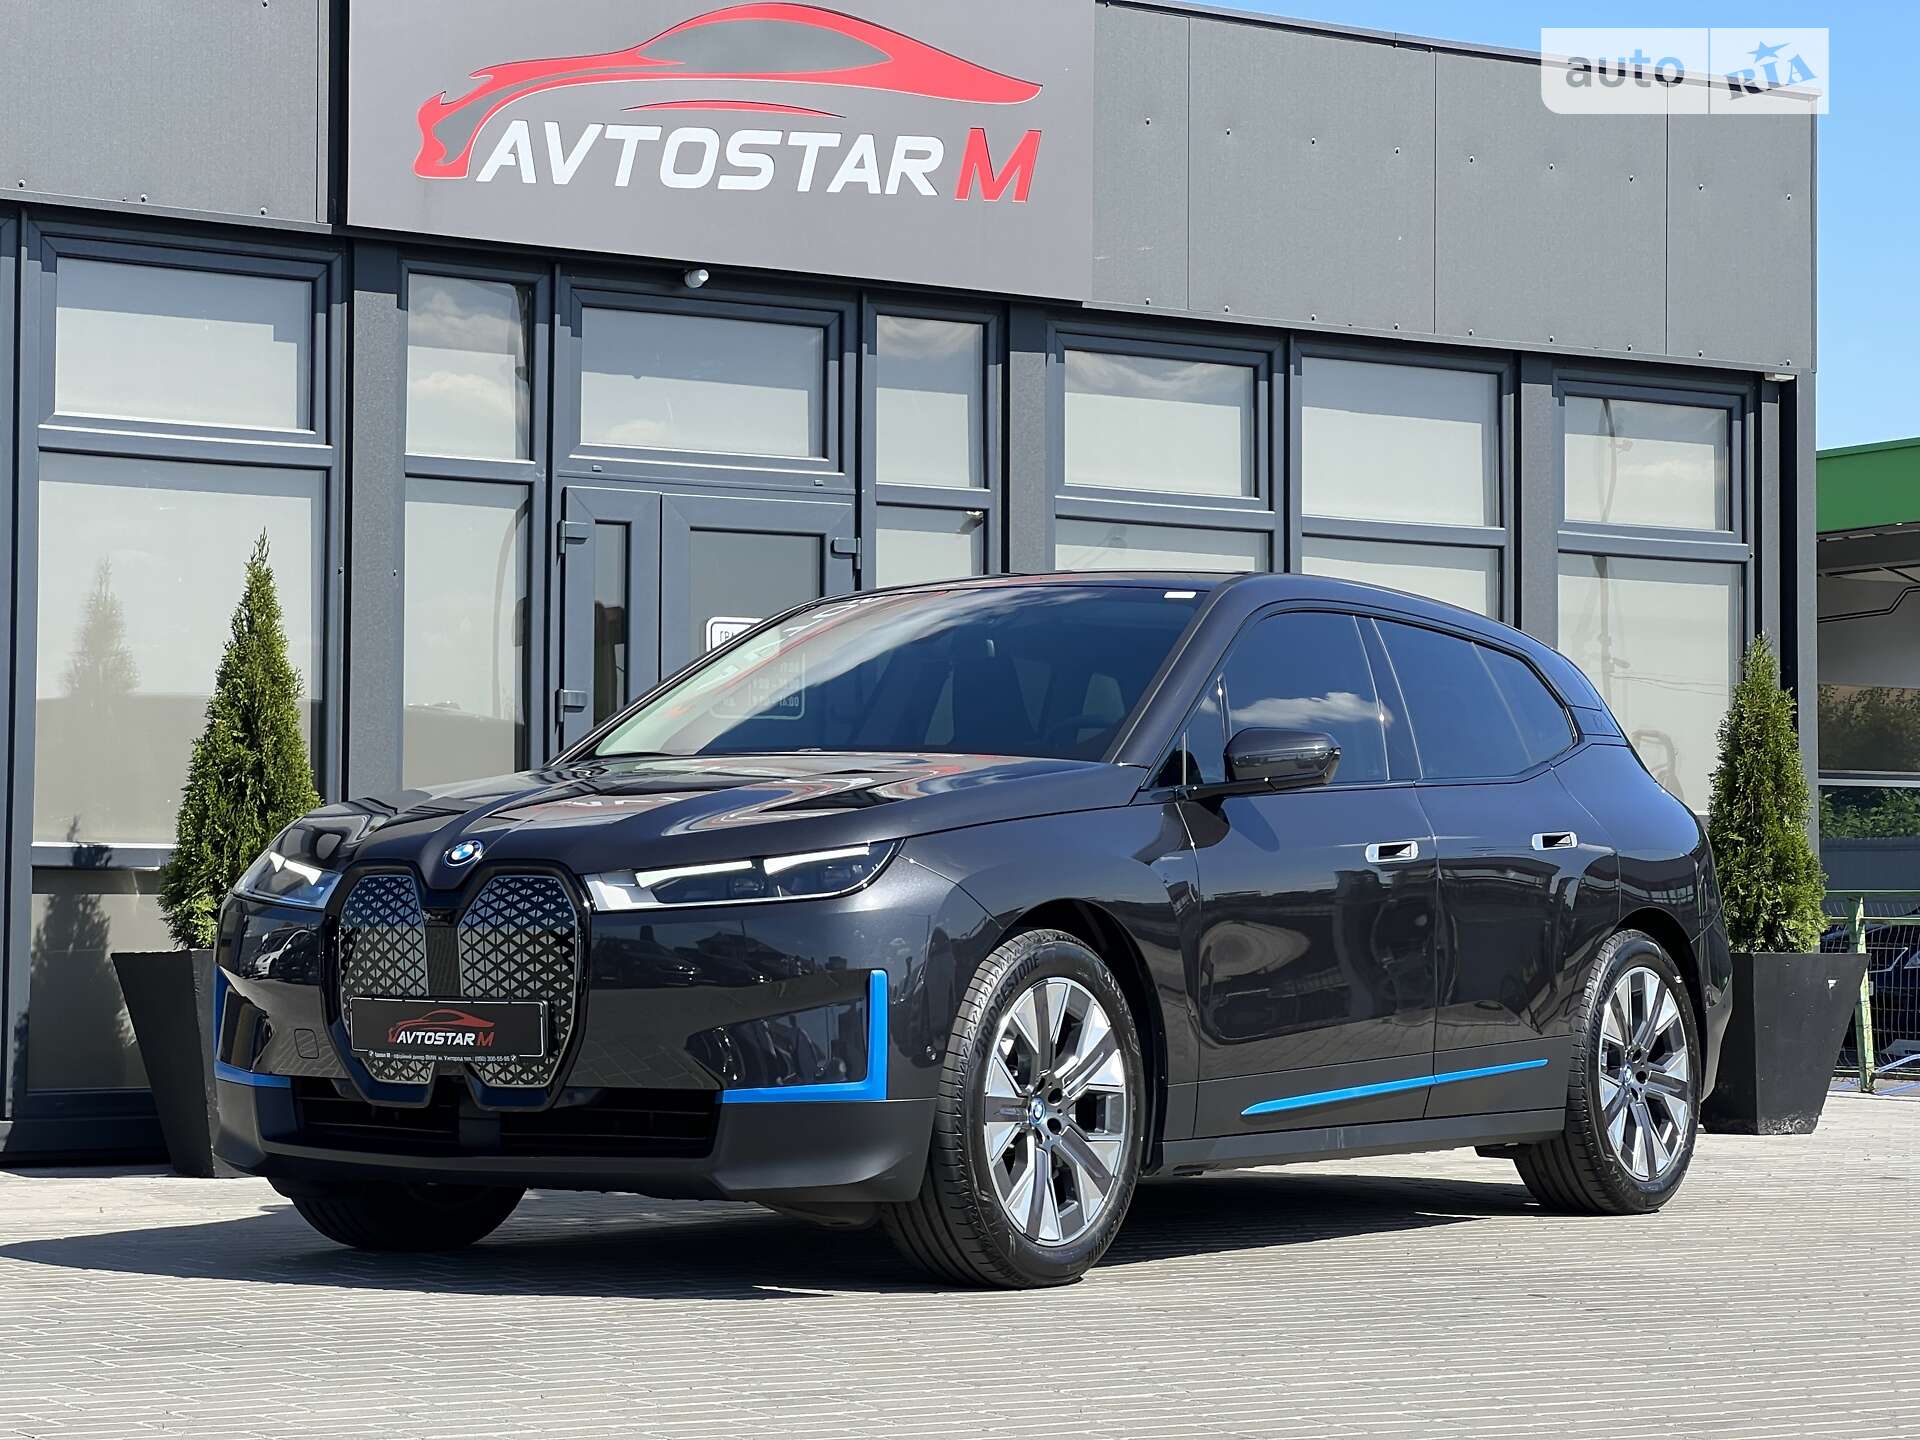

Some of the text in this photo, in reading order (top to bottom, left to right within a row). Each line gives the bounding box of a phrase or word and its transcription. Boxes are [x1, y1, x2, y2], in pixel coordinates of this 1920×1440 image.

[476, 120, 1042, 203] AVTOSTAR M
[396, 1031, 494, 1047] AVTOSTAR M
